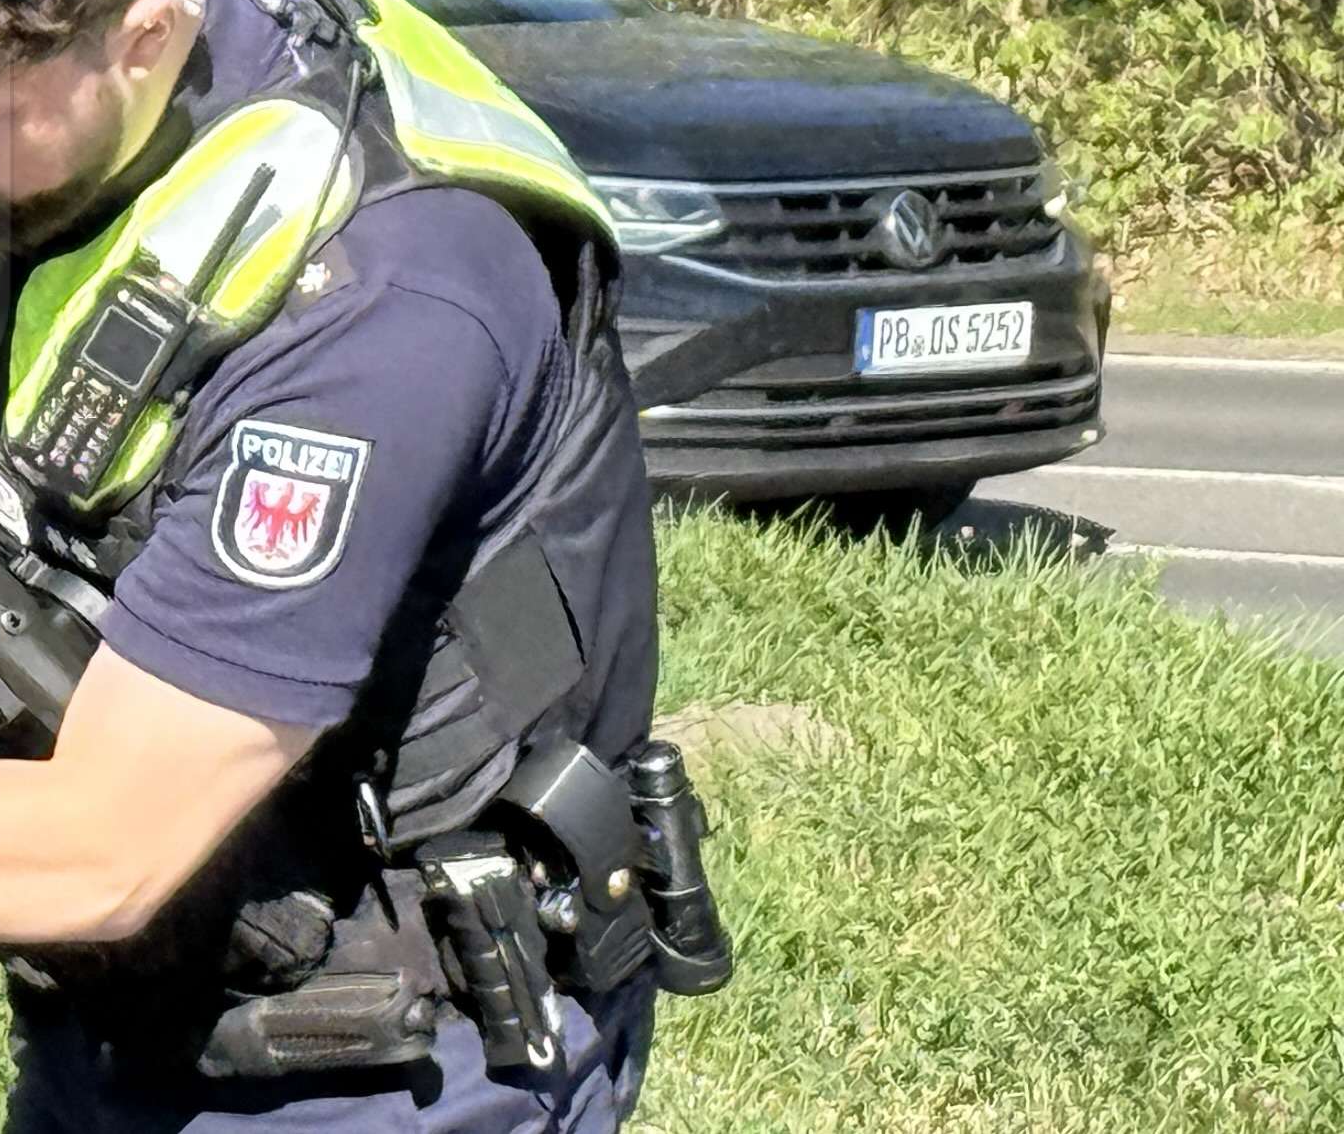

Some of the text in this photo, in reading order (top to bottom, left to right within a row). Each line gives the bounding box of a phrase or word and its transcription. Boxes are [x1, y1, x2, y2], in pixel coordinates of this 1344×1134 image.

[878, 317, 910, 359] PB
[966, 310, 1025, 353] 5252
[242, 434, 353, 482] POLIZEI
